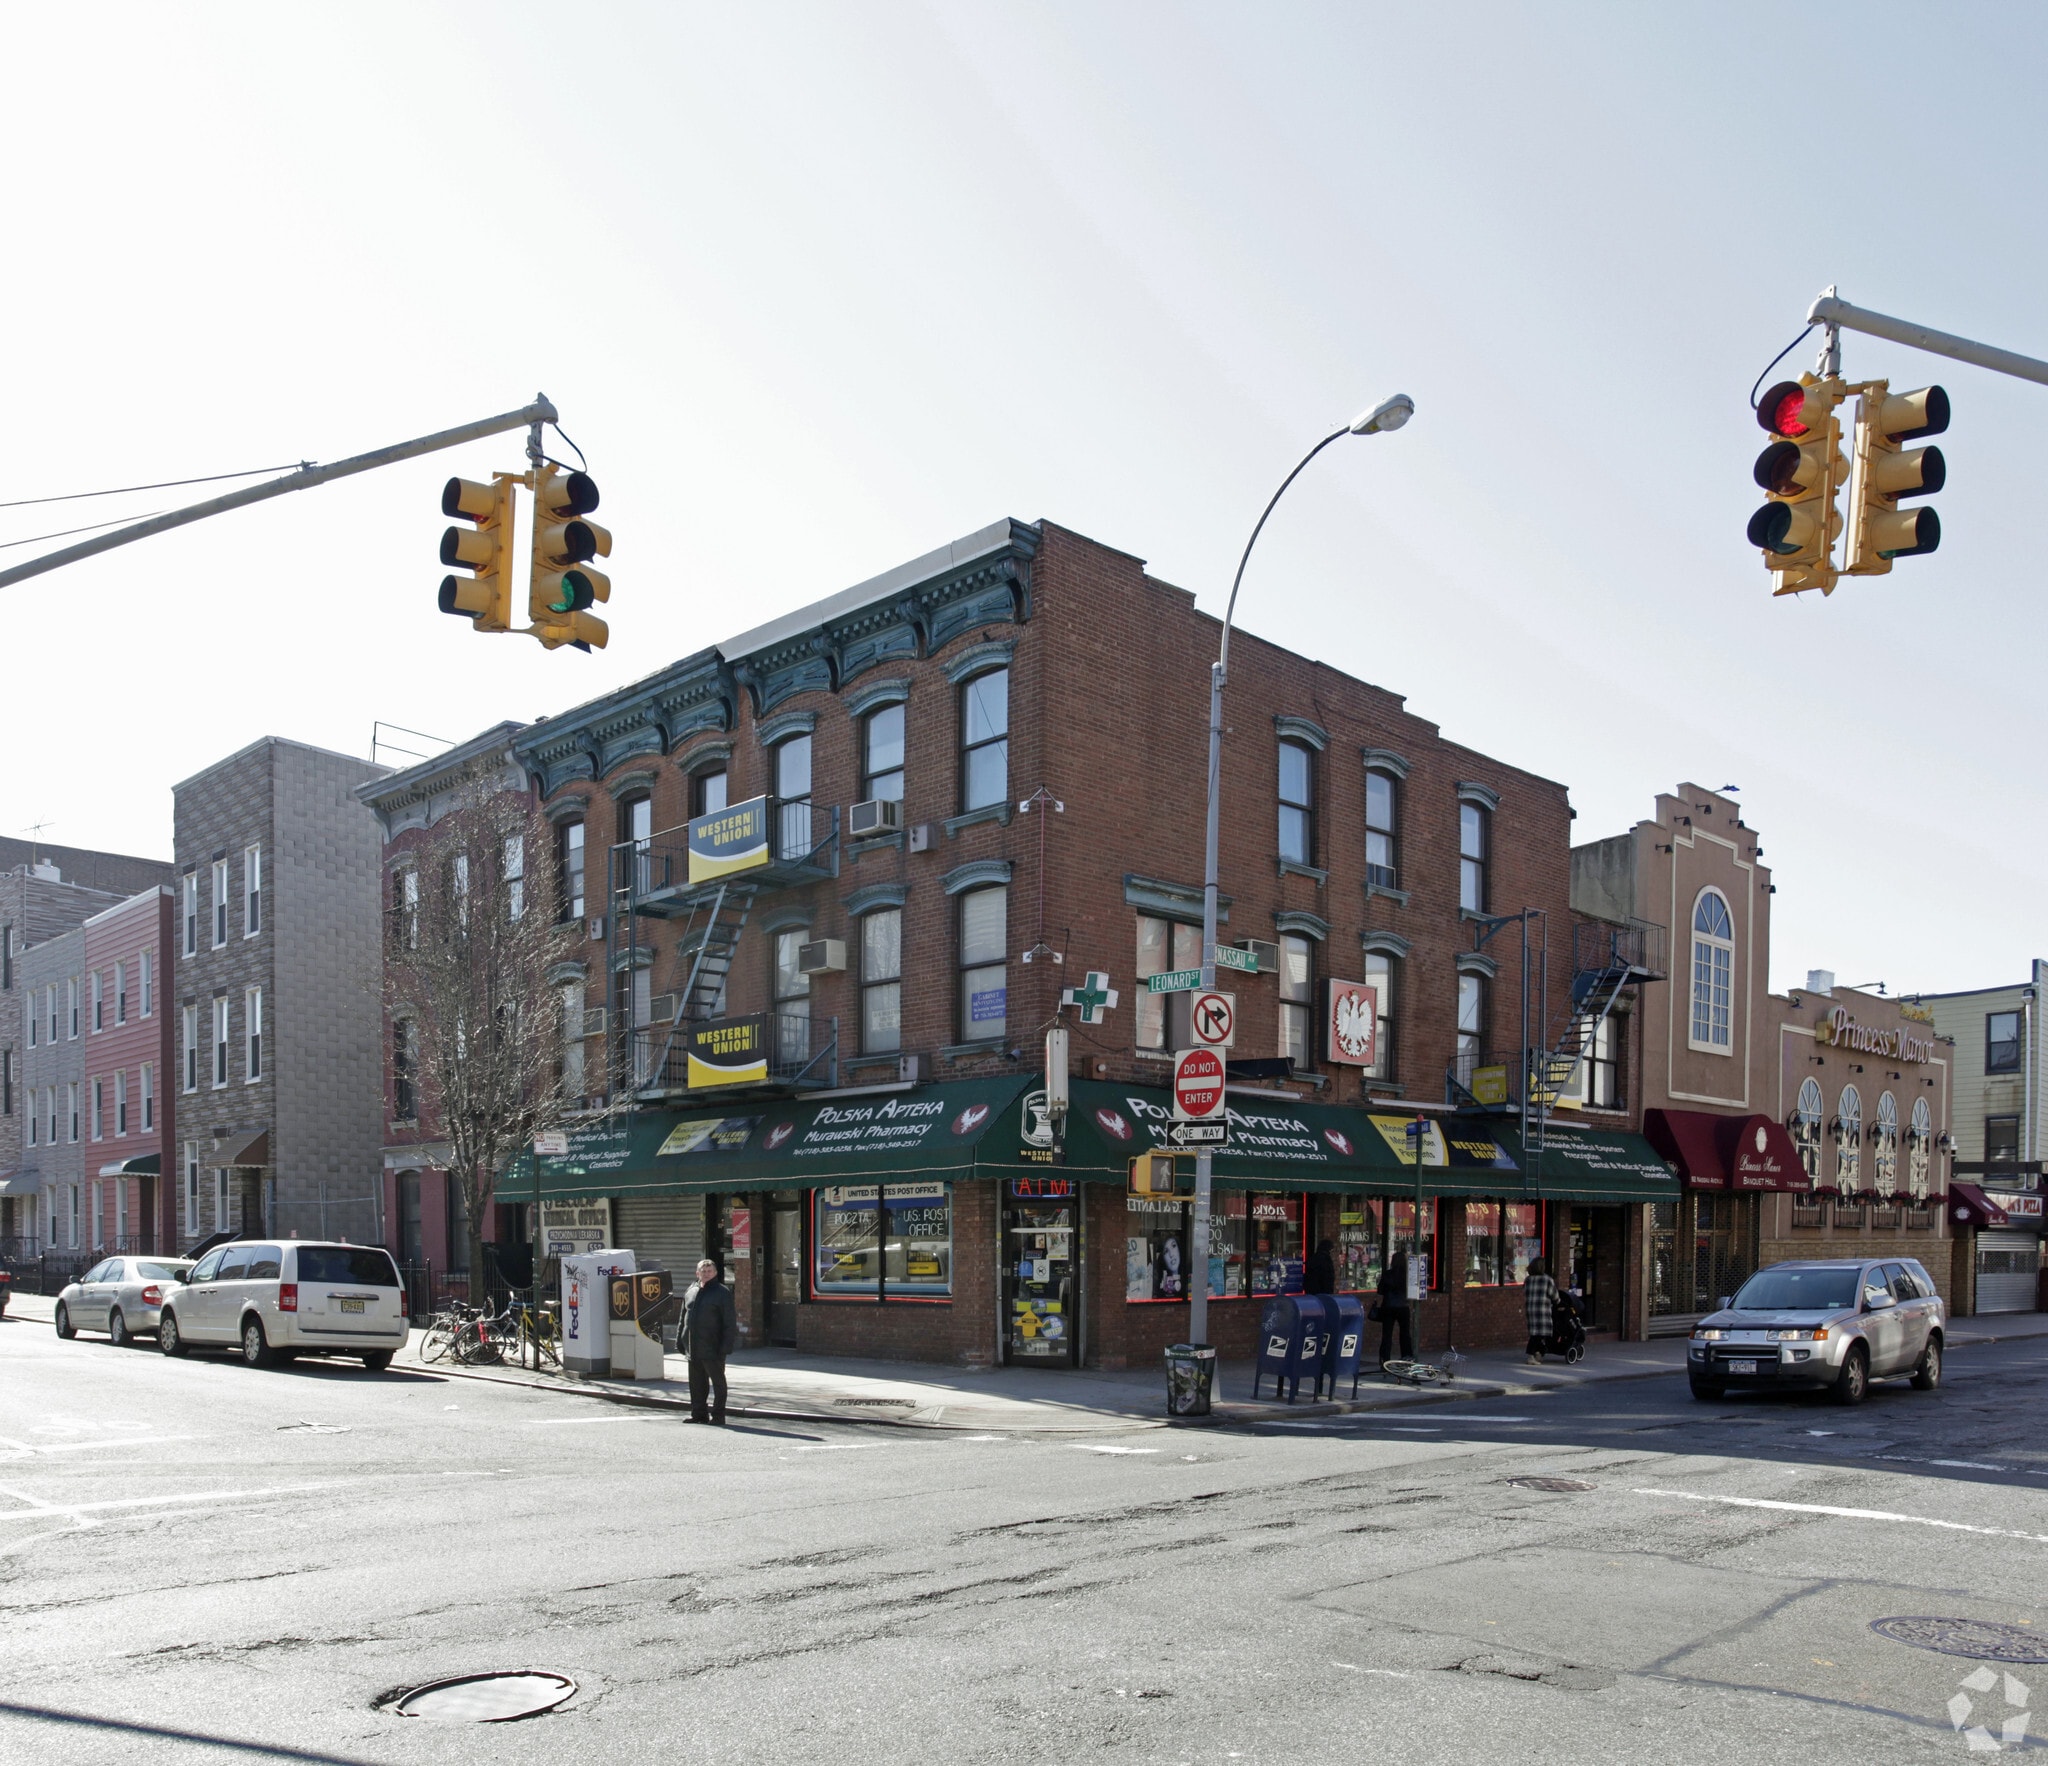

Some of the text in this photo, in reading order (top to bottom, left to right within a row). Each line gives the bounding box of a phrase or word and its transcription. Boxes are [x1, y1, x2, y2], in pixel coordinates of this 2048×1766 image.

[698, 811, 750, 839] WESTERN
[714, 824, 751, 846] UNION
[1217, 947, 1256, 968] NASSAU AV
[1151, 971, 1199, 992] LEONARD ST
[697, 1025, 749, 1044] WESTERN
[1831, 1005, 1934, 1064] Princess Manor
[713, 1038, 750, 1055] UNION
[1184, 1062, 1216, 1074] DO NOT
[1185, 1092, 1213, 1104] ENTER
[803, 1123, 933, 1143] Murawski Pharmacy
[1176, 1129, 1194, 1139] ONE
[1202, 1128, 1220, 1138] WAY
[1236, 1131, 1319, 1151] Pharmacy
[1450, 1140, 1496, 1151] WESTERN
[1765, 1177, 1777, 1186] HALL
[848, 1188, 869, 1198] UNITED
[897, 1186, 914, 1195] POST
[914, 1185, 938, 1194] OFFICE
[924, 1208, 949, 1220] POST
[2023, 1199, 2041, 1214] PIZZA
[834, 1212, 870, 1225] POCZTA
[908, 1223, 944, 1236] OFFICE
[597, 1265, 624, 1276] FedEx
[643, 1283, 659, 1298] ups
[614, 1292, 628, 1312] ups
[568, 1282, 579, 1340] FedEx
